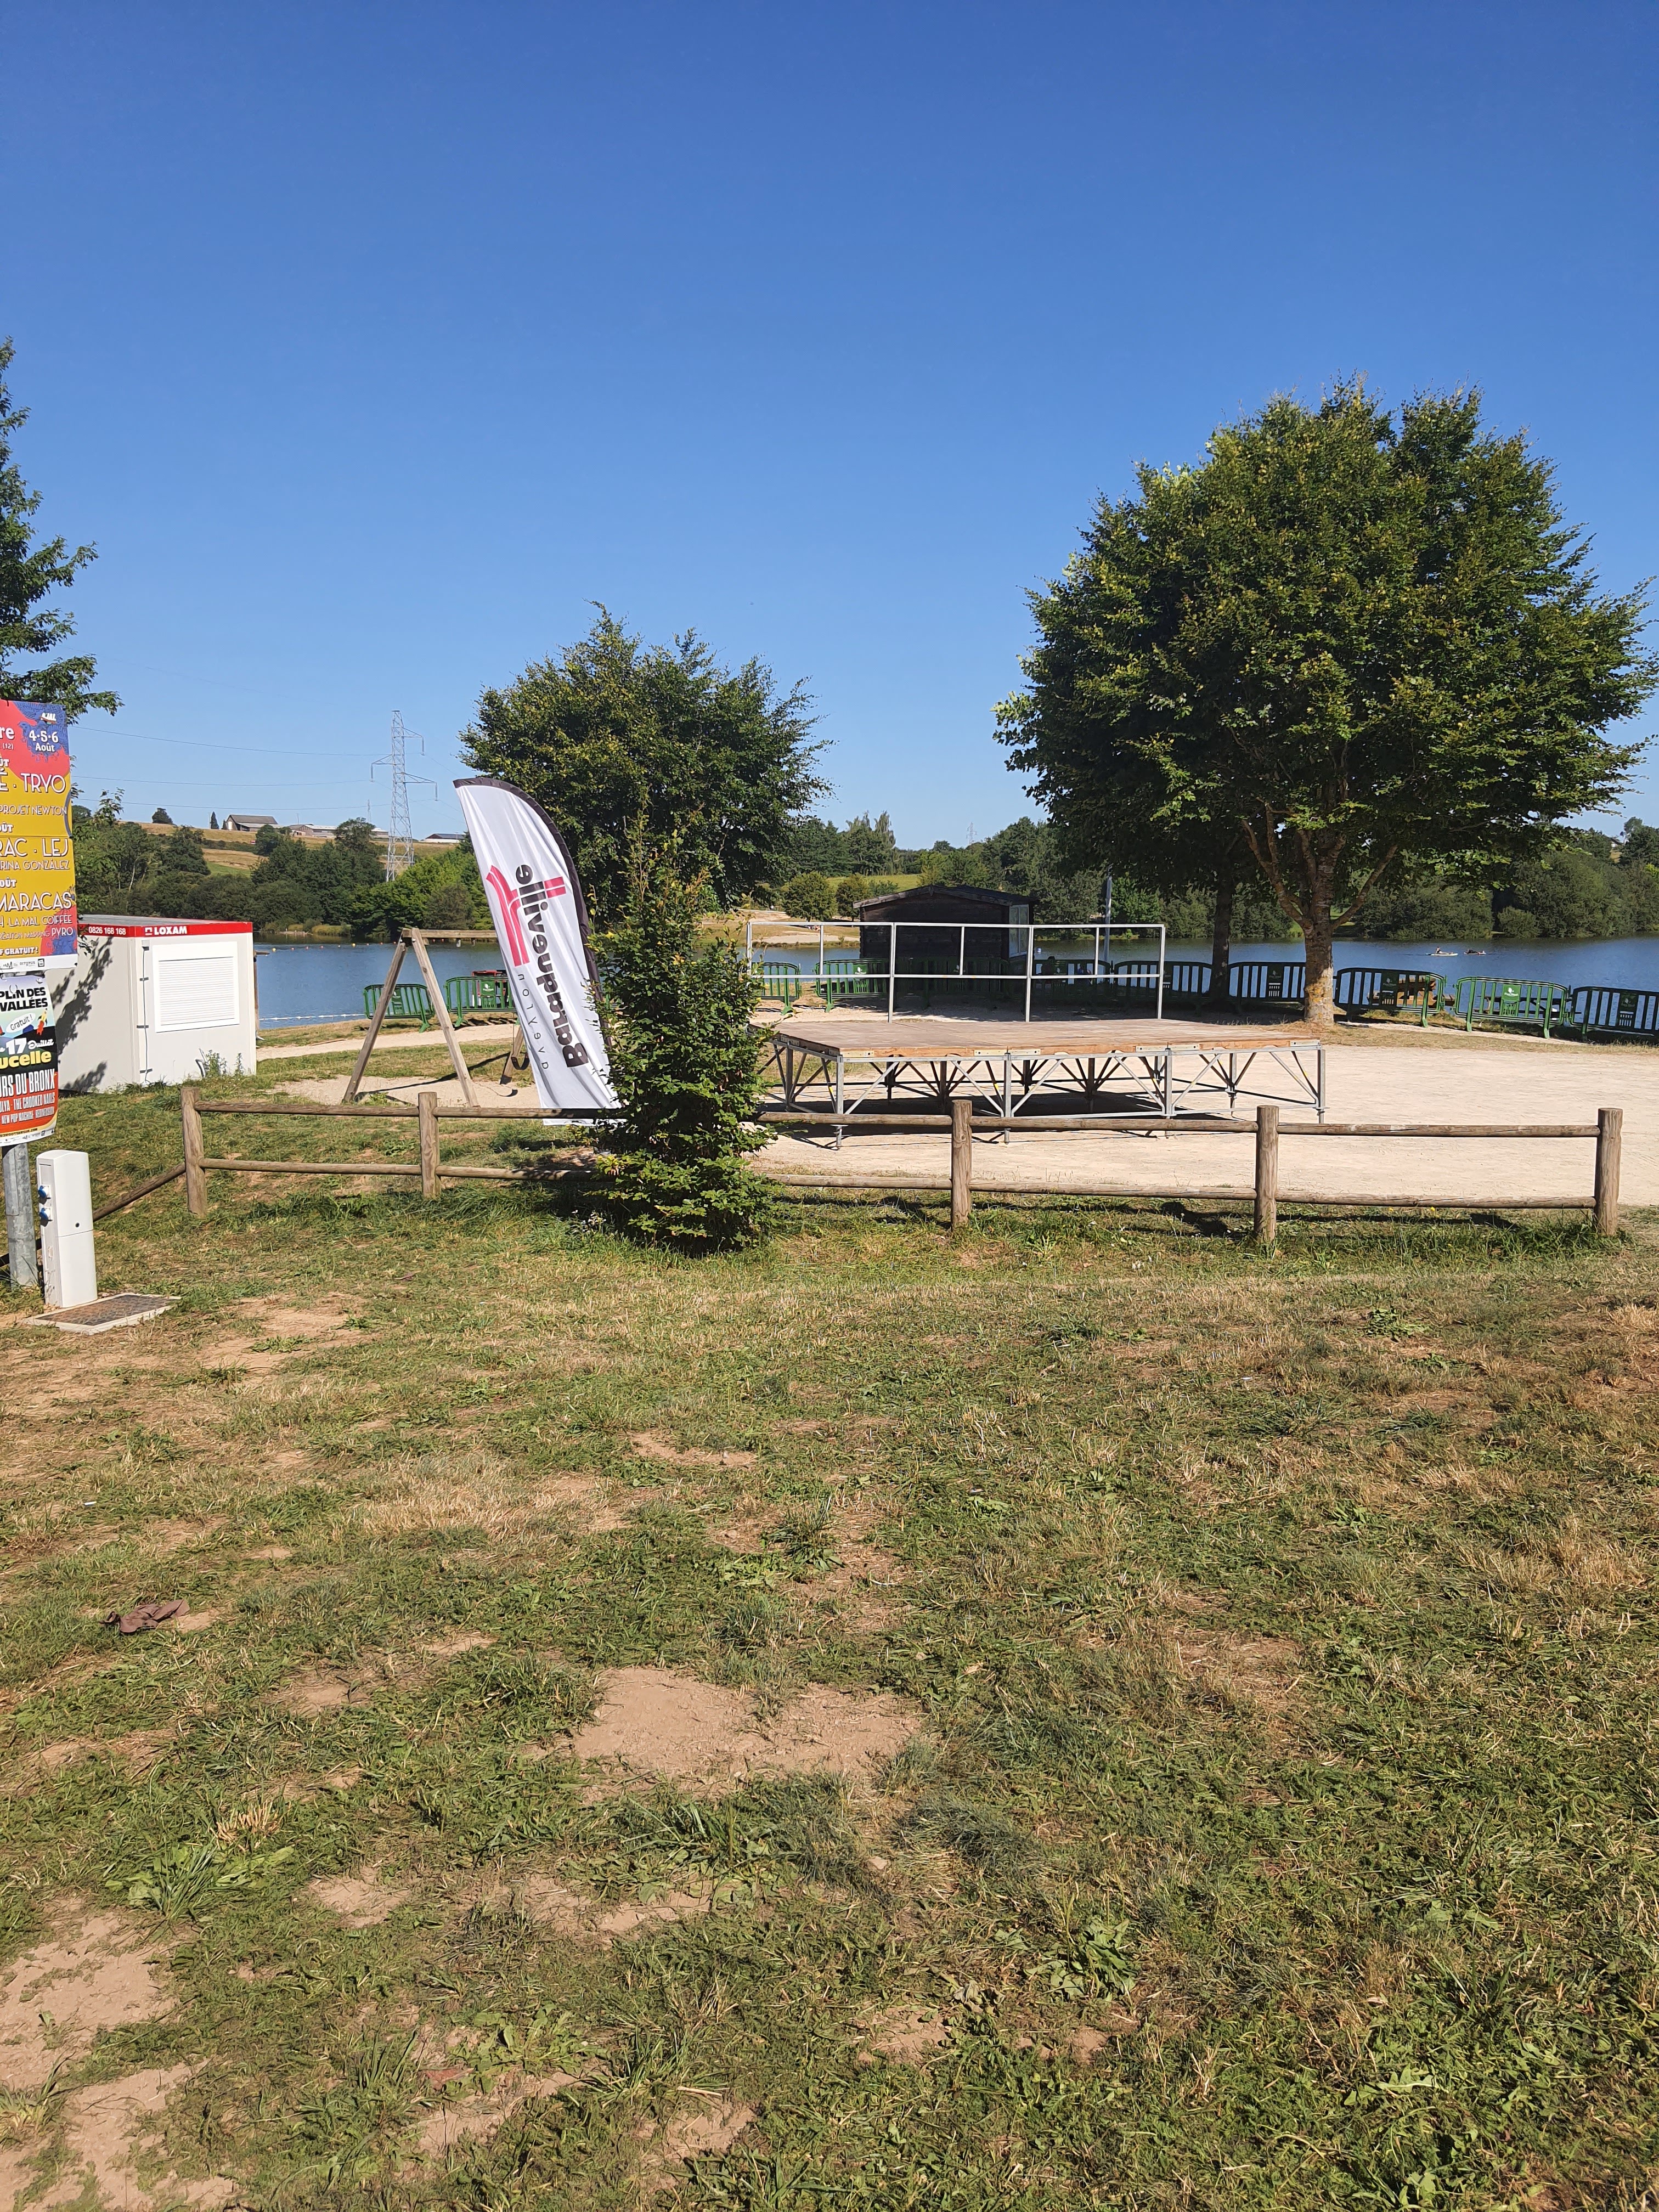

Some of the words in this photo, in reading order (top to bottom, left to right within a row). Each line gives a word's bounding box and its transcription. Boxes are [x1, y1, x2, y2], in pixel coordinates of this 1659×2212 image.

[35, 742, 55, 752] Août
[21, 772, 66, 793] TRYO
[32, 805, 67, 816] NEWTON
[42, 838, 69, 857] LEJ
[23, 858, 70, 870] GONZÁLEZ
[9, 917, 20, 927] LA
[22, 916, 40, 926] MAL
[42, 913, 72, 925] COIFFÉE
[52, 927, 74, 937] PYRO
[88, 926, 103, 934] 0826
[154, 926, 188, 935] LOXAM
[26, 987, 46, 997] DES
[0, 997, 48, 1012] VALLÉES
[6, 1037, 27, 1055] 17
[15, 1073, 27, 1096] DU
[29, 1069, 55, 1093] BRONX
[14, 1098, 22, 1110] THE
[23, 1094, 43, 1109] CROOKED
[43, 1092, 55, 1104] NAILS
